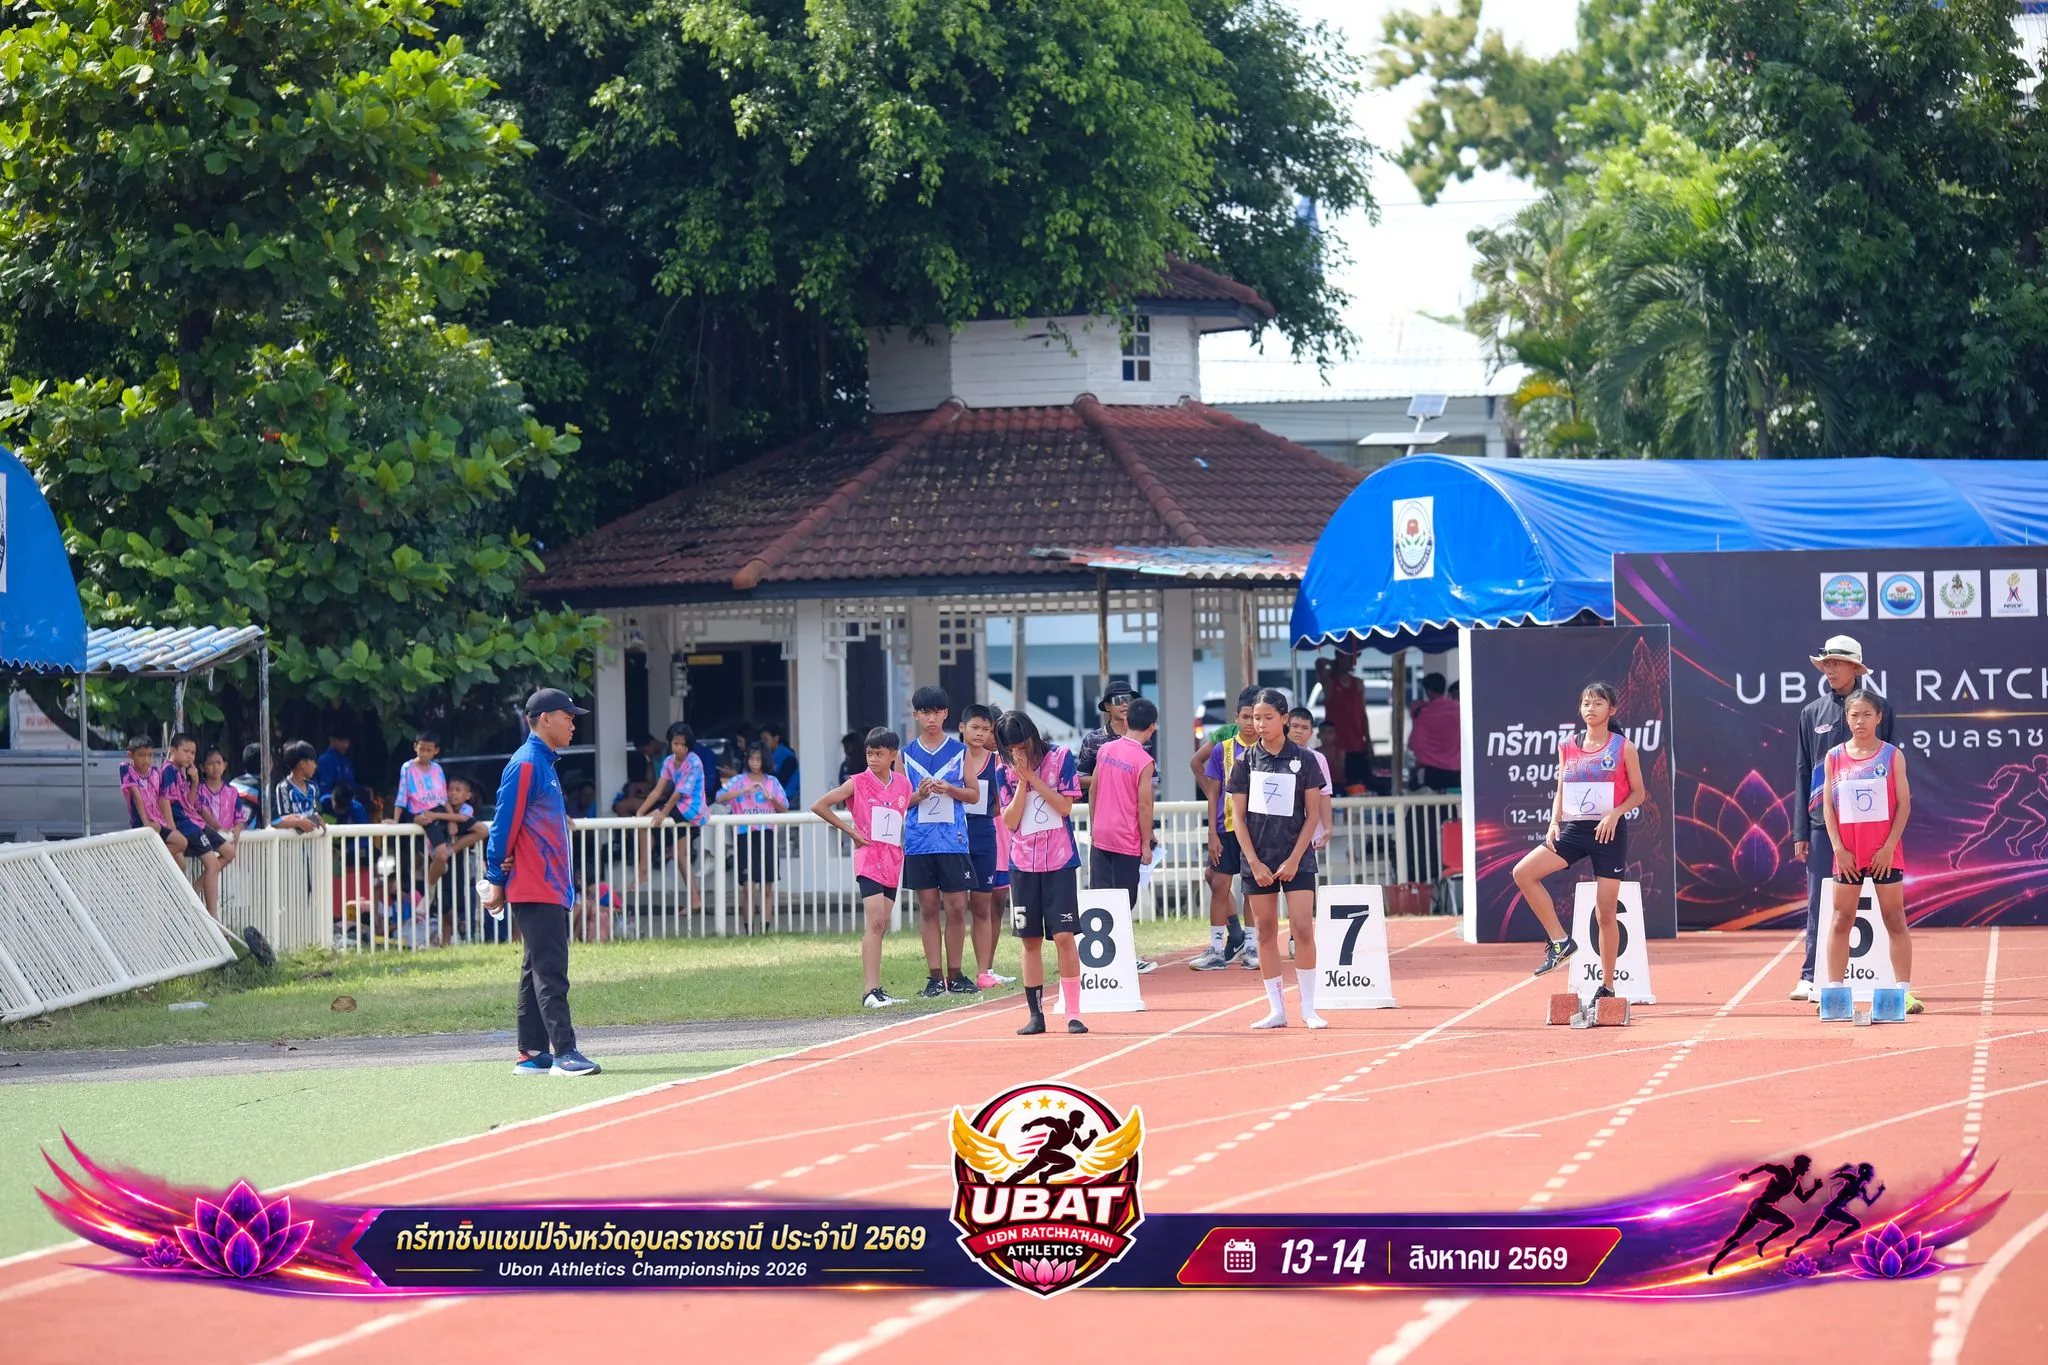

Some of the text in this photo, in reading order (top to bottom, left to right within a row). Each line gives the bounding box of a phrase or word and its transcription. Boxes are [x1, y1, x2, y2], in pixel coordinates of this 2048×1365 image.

[1916, 667, 2048, 701] RATC
[1263, 782, 1282, 804] 7
[1580, 788, 1596, 813] 6
[1855, 788, 1873, 811] 5
[928, 796, 941, 816] 2
[1033, 794, 1049, 824] 8
[881, 813, 893, 836] 1
[1013, 906, 1027, 929] 5
[1589, 899, 1629, 959] 6
[1848, 896, 1874, 958] 5
[1078, 907, 1116, 968] 8
[1330, 905, 1369, 966] 7
[1325, 970, 1371, 988] Nelco
[1583, 963, 1630, 981] Neco
[1843, 963, 1875, 980] elco
